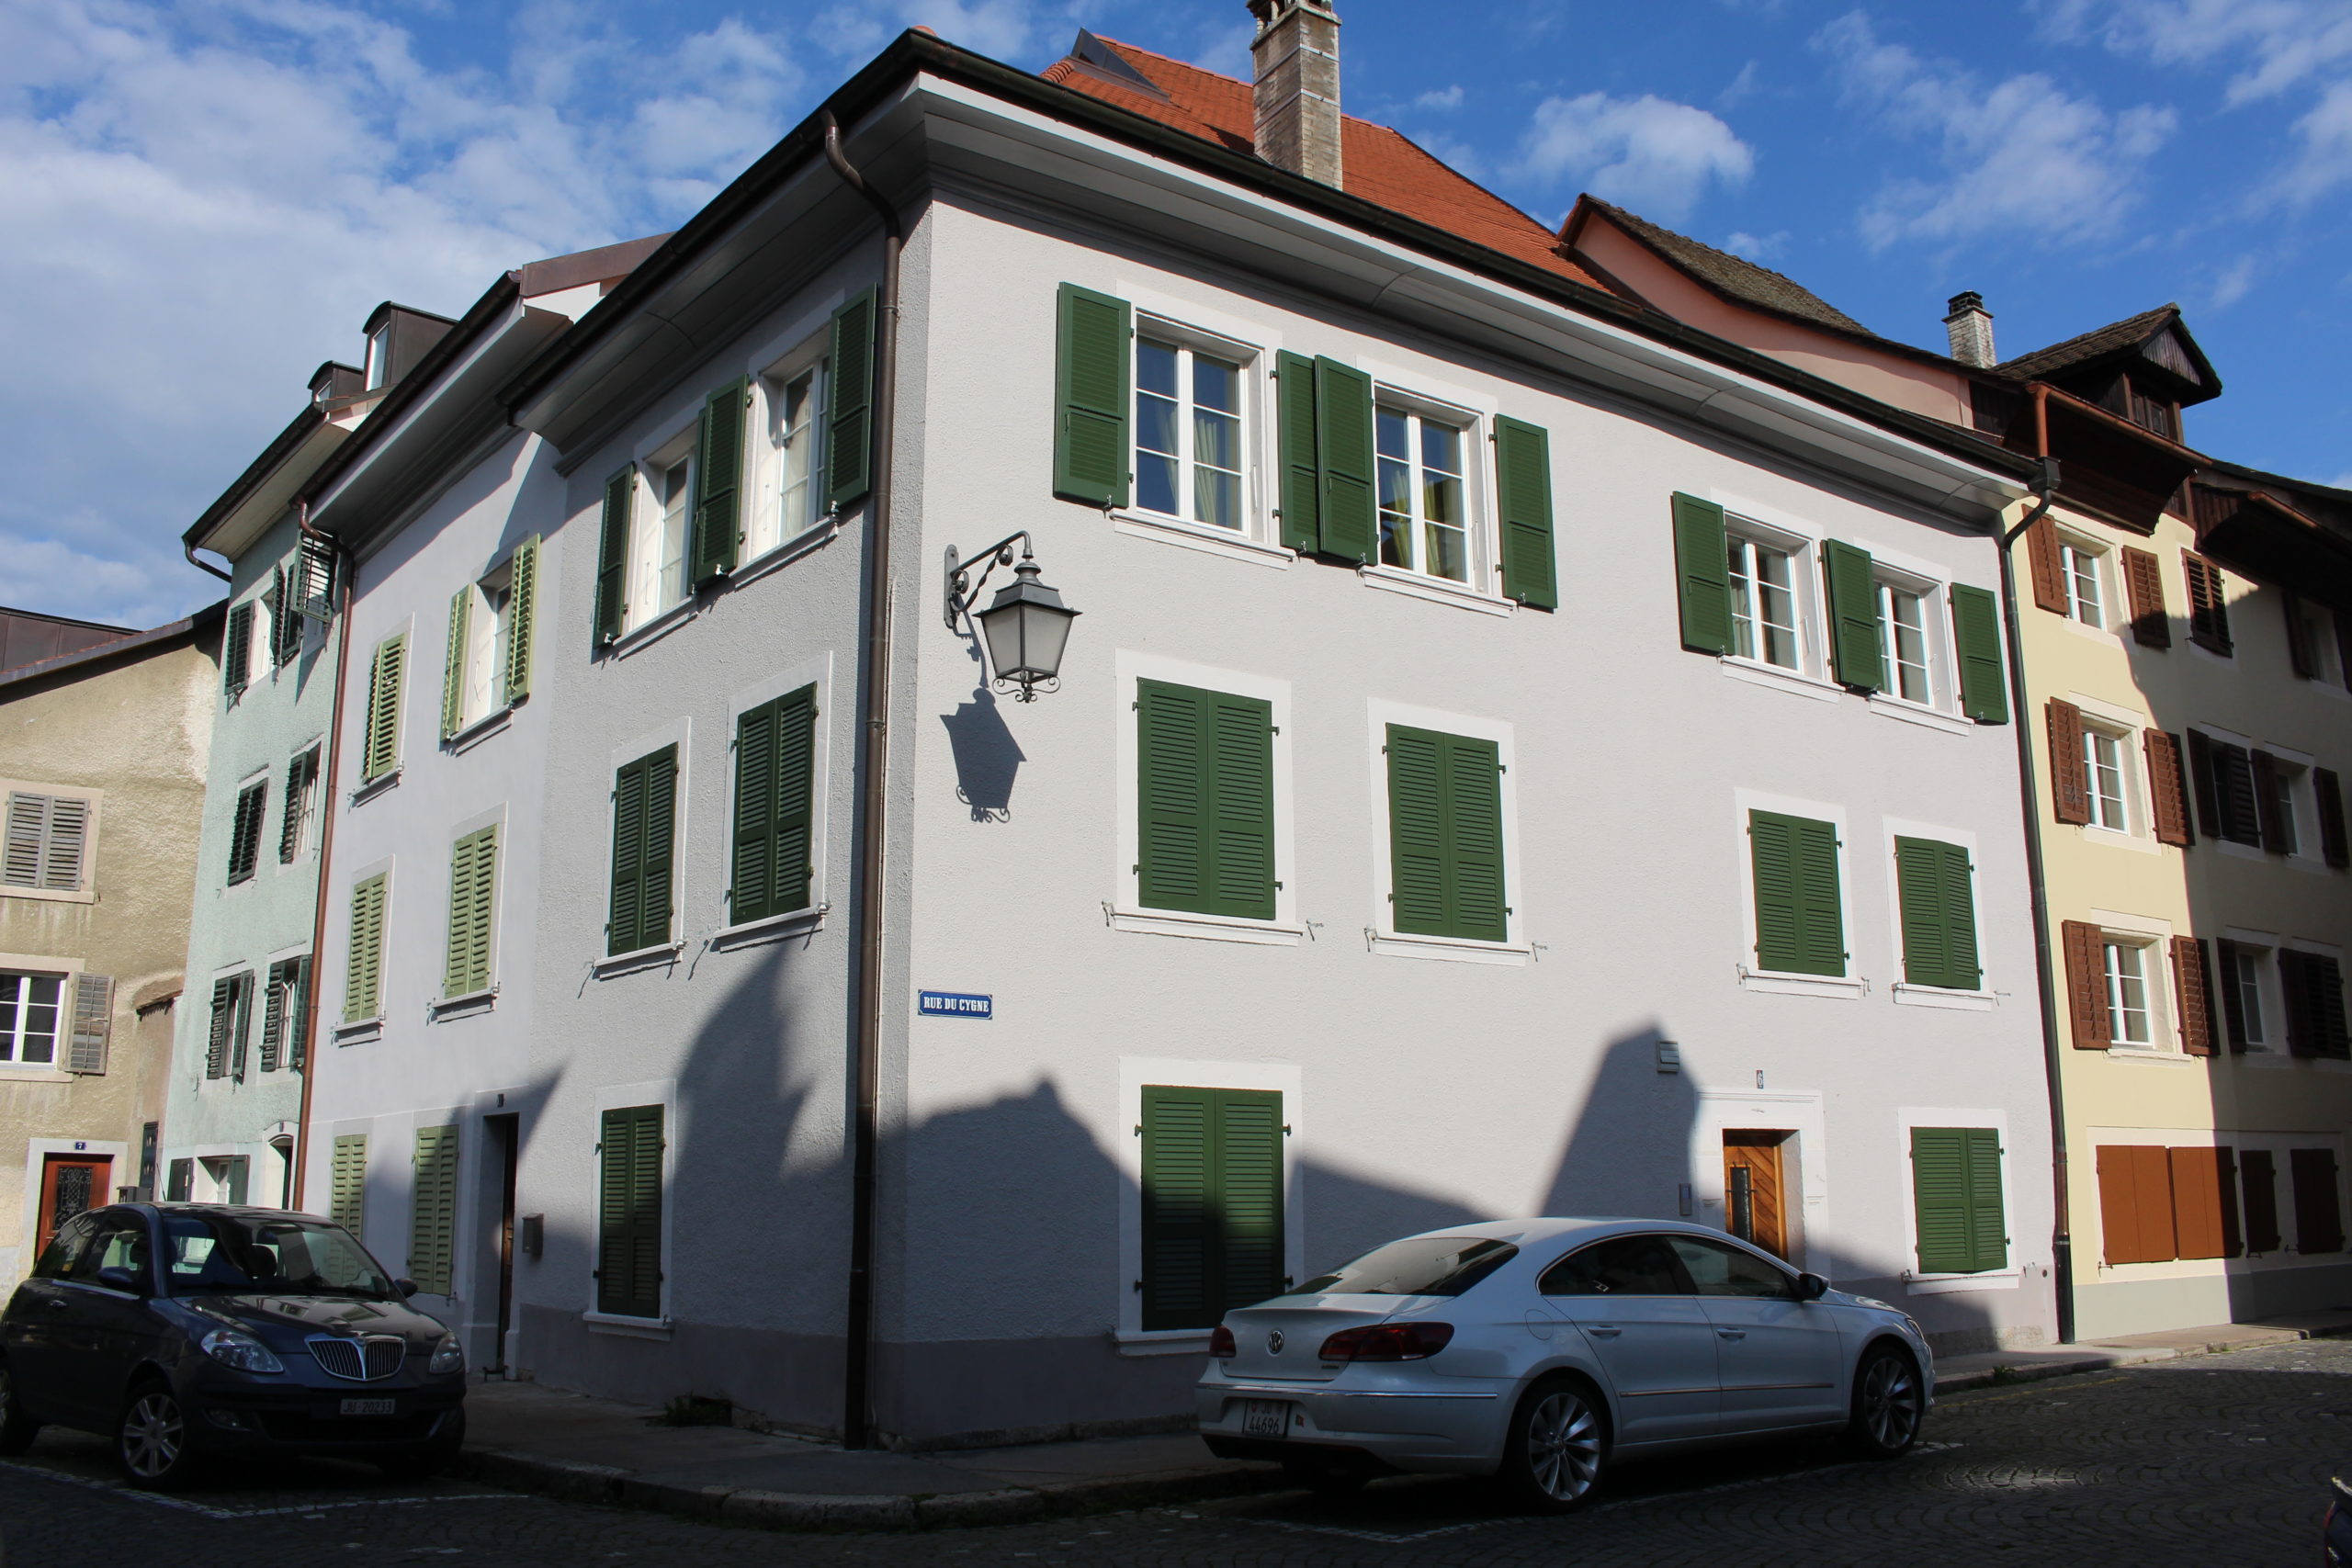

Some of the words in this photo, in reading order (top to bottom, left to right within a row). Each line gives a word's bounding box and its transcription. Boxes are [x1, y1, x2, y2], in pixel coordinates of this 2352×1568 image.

[923, 997, 943, 1010] RUE
[944, 998, 957, 1010] DU
[959, 998, 989, 1012] CYGNE
[1249, 1416, 1280, 1434] 44696
